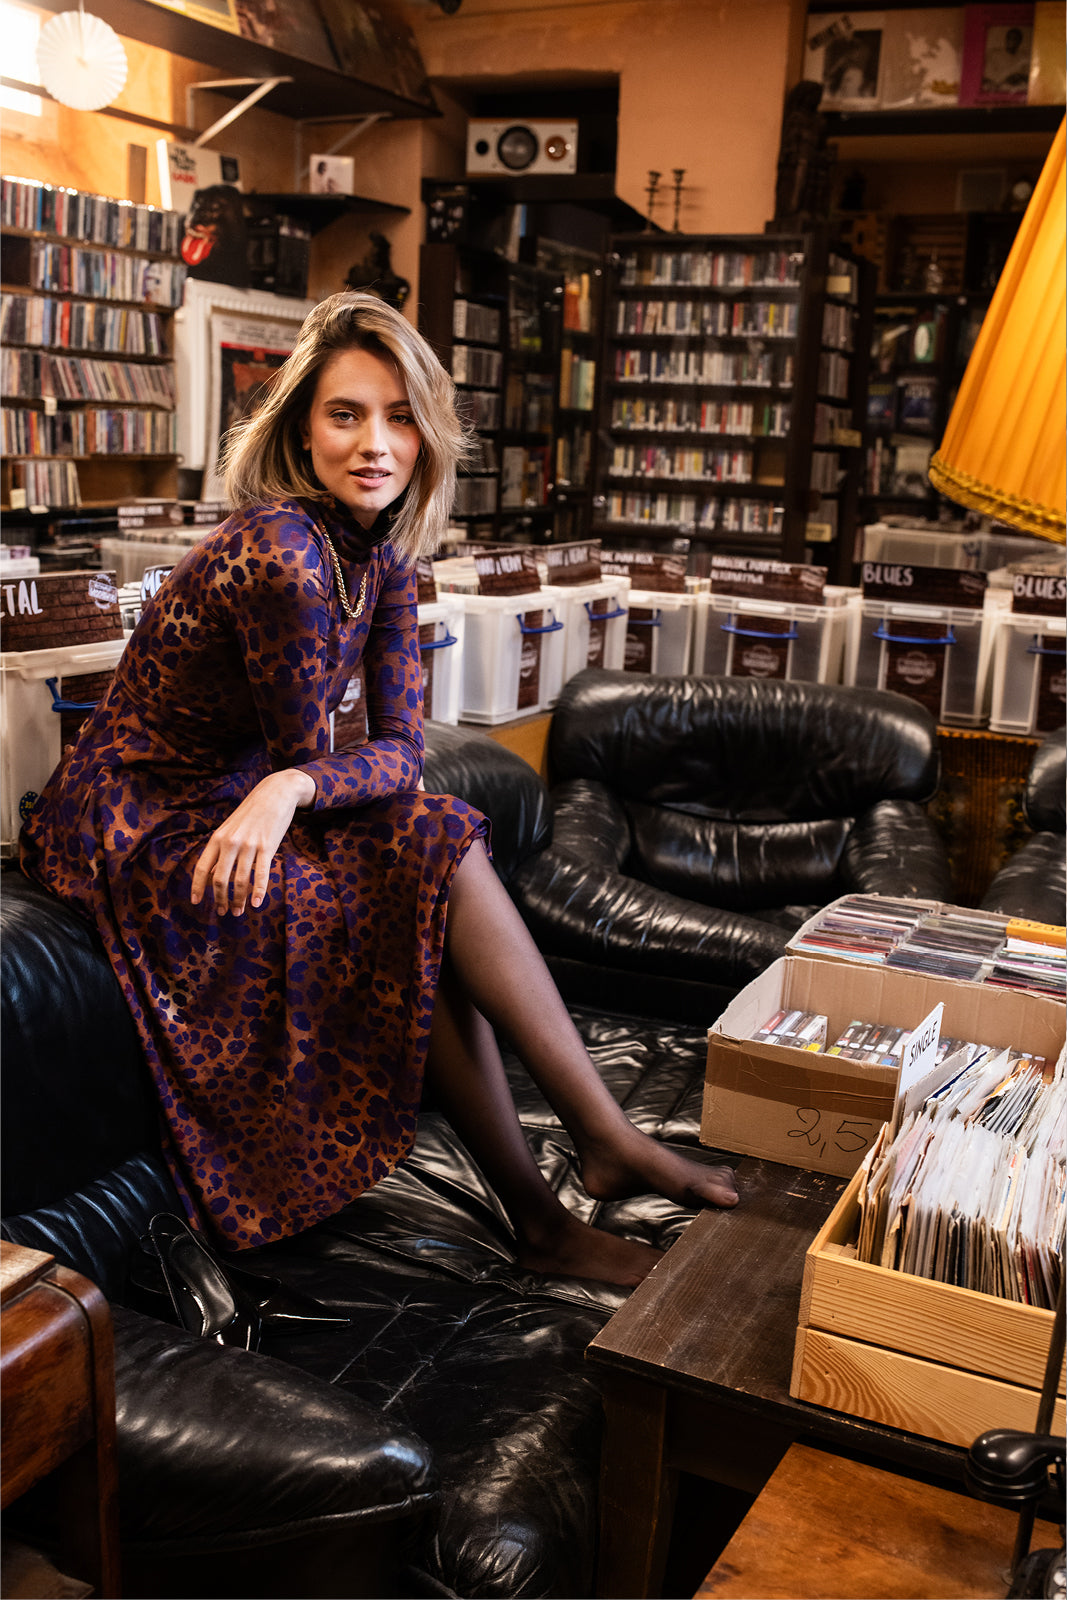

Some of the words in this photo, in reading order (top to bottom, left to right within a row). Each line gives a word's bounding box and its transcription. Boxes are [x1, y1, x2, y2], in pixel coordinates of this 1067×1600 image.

[141, 569, 172, 602] ME
[863, 563, 914, 586] BLUES
[1013, 575, 1066, 600] BLUES
[1, 580, 43, 618] TAL
[908, 1020, 938, 1068] SINGLE
[787, 1107, 879, 1158] 2,5
